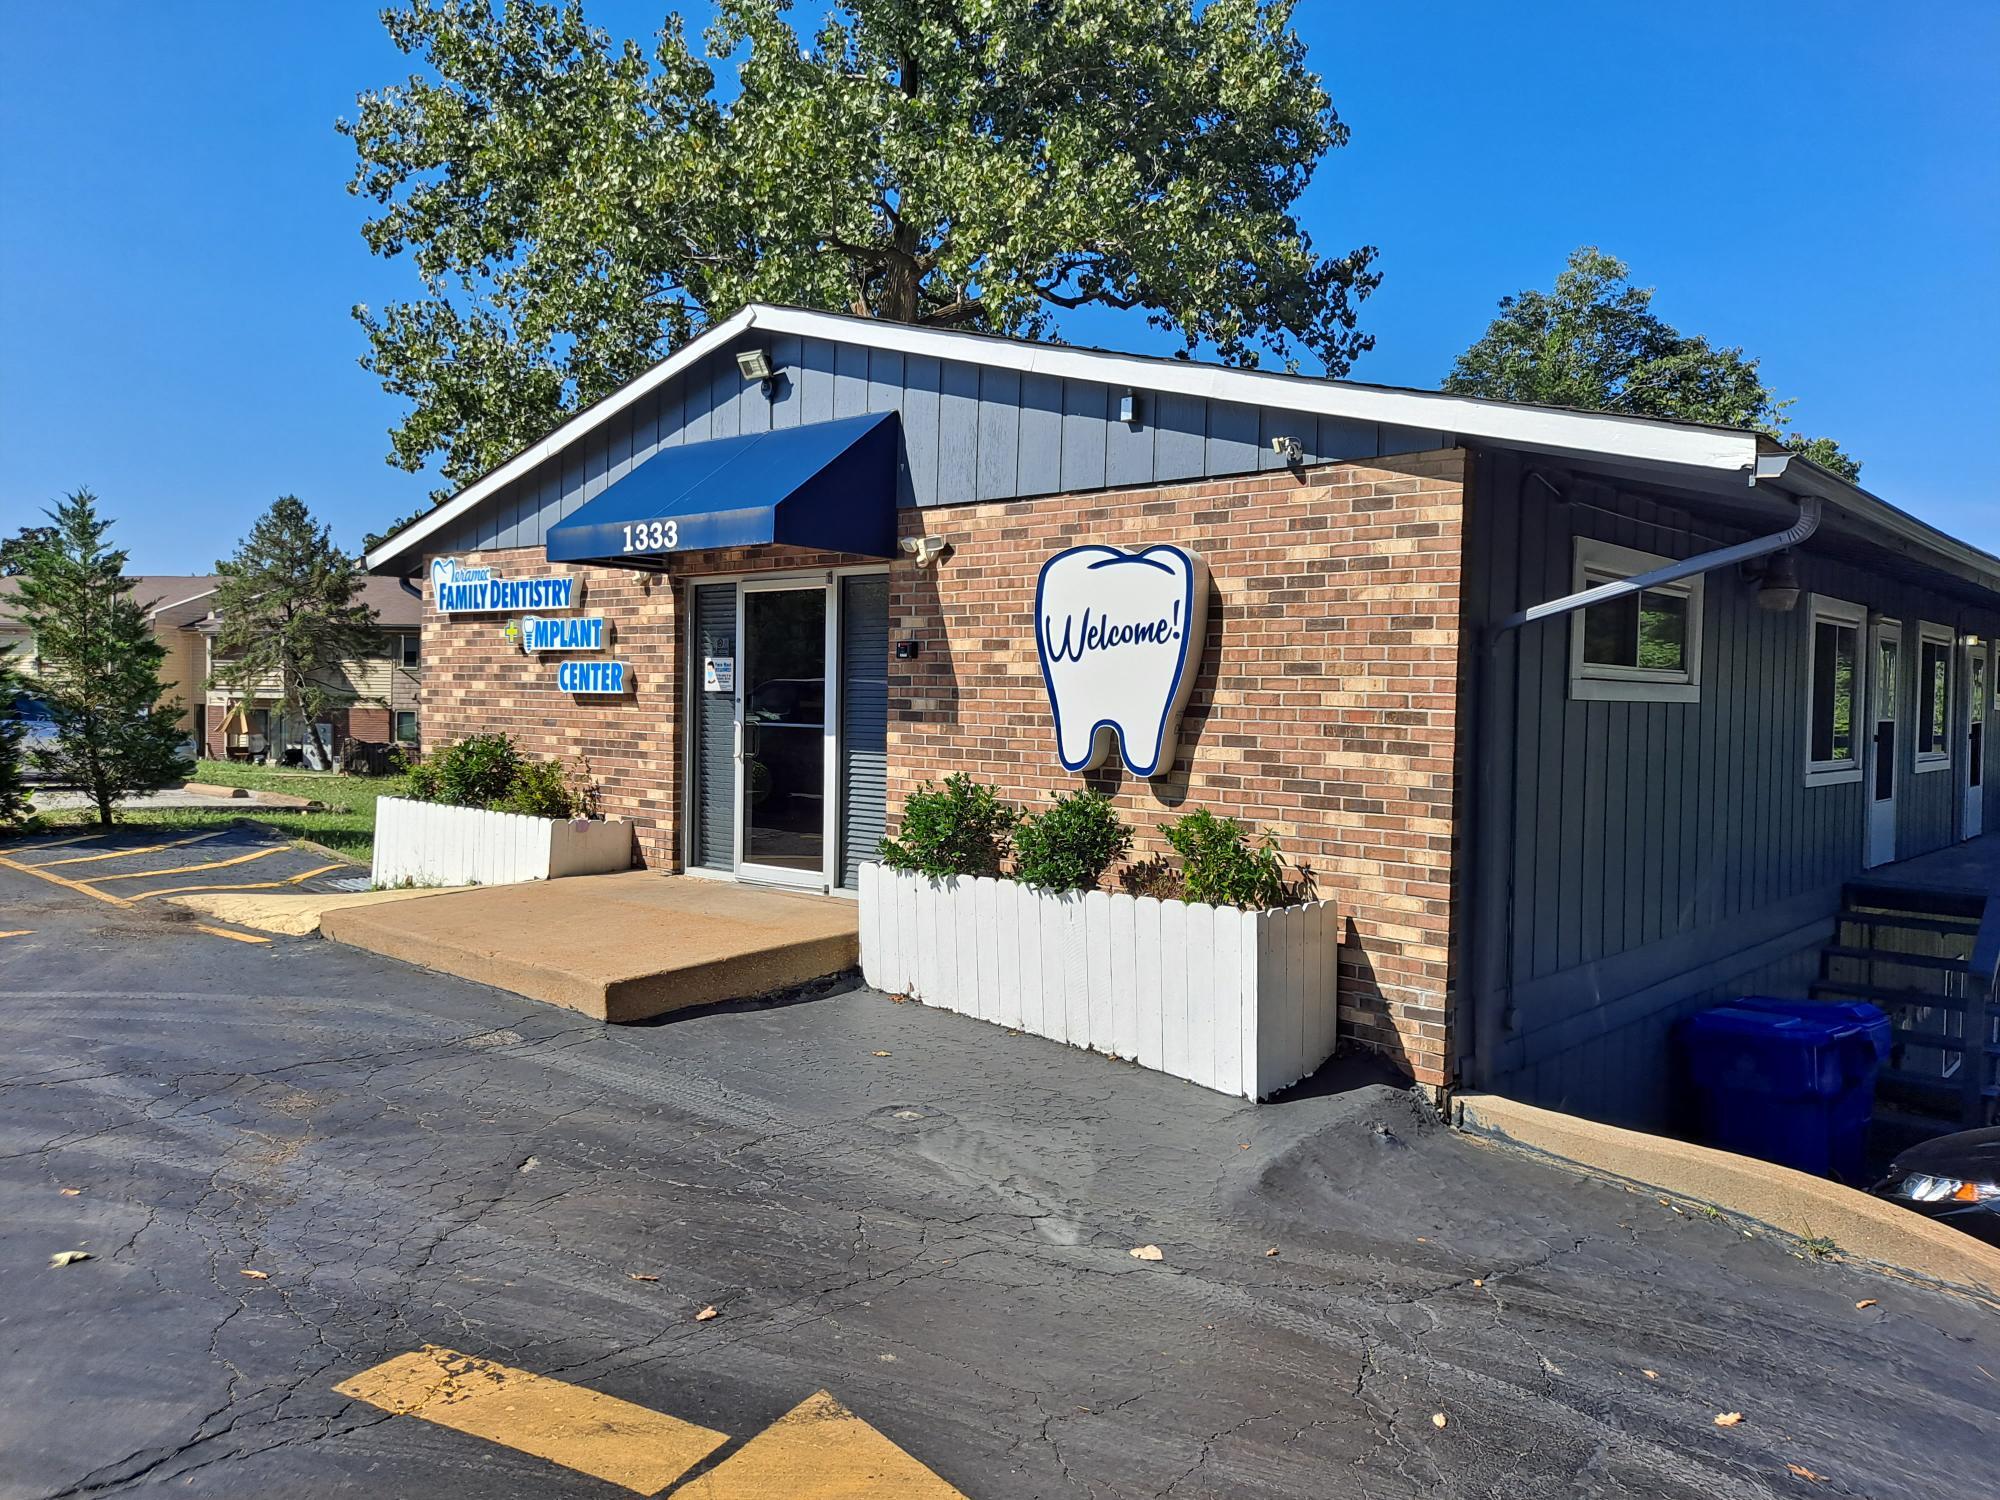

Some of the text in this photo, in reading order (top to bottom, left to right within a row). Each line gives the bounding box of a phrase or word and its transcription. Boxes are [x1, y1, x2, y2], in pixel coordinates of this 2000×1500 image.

[623, 520, 678, 552] 1333
[439, 579, 573, 611] FAMILY DENTISTRY
[1045, 599, 1181, 663] Welcome!
[559, 662, 623, 691] CENTER
